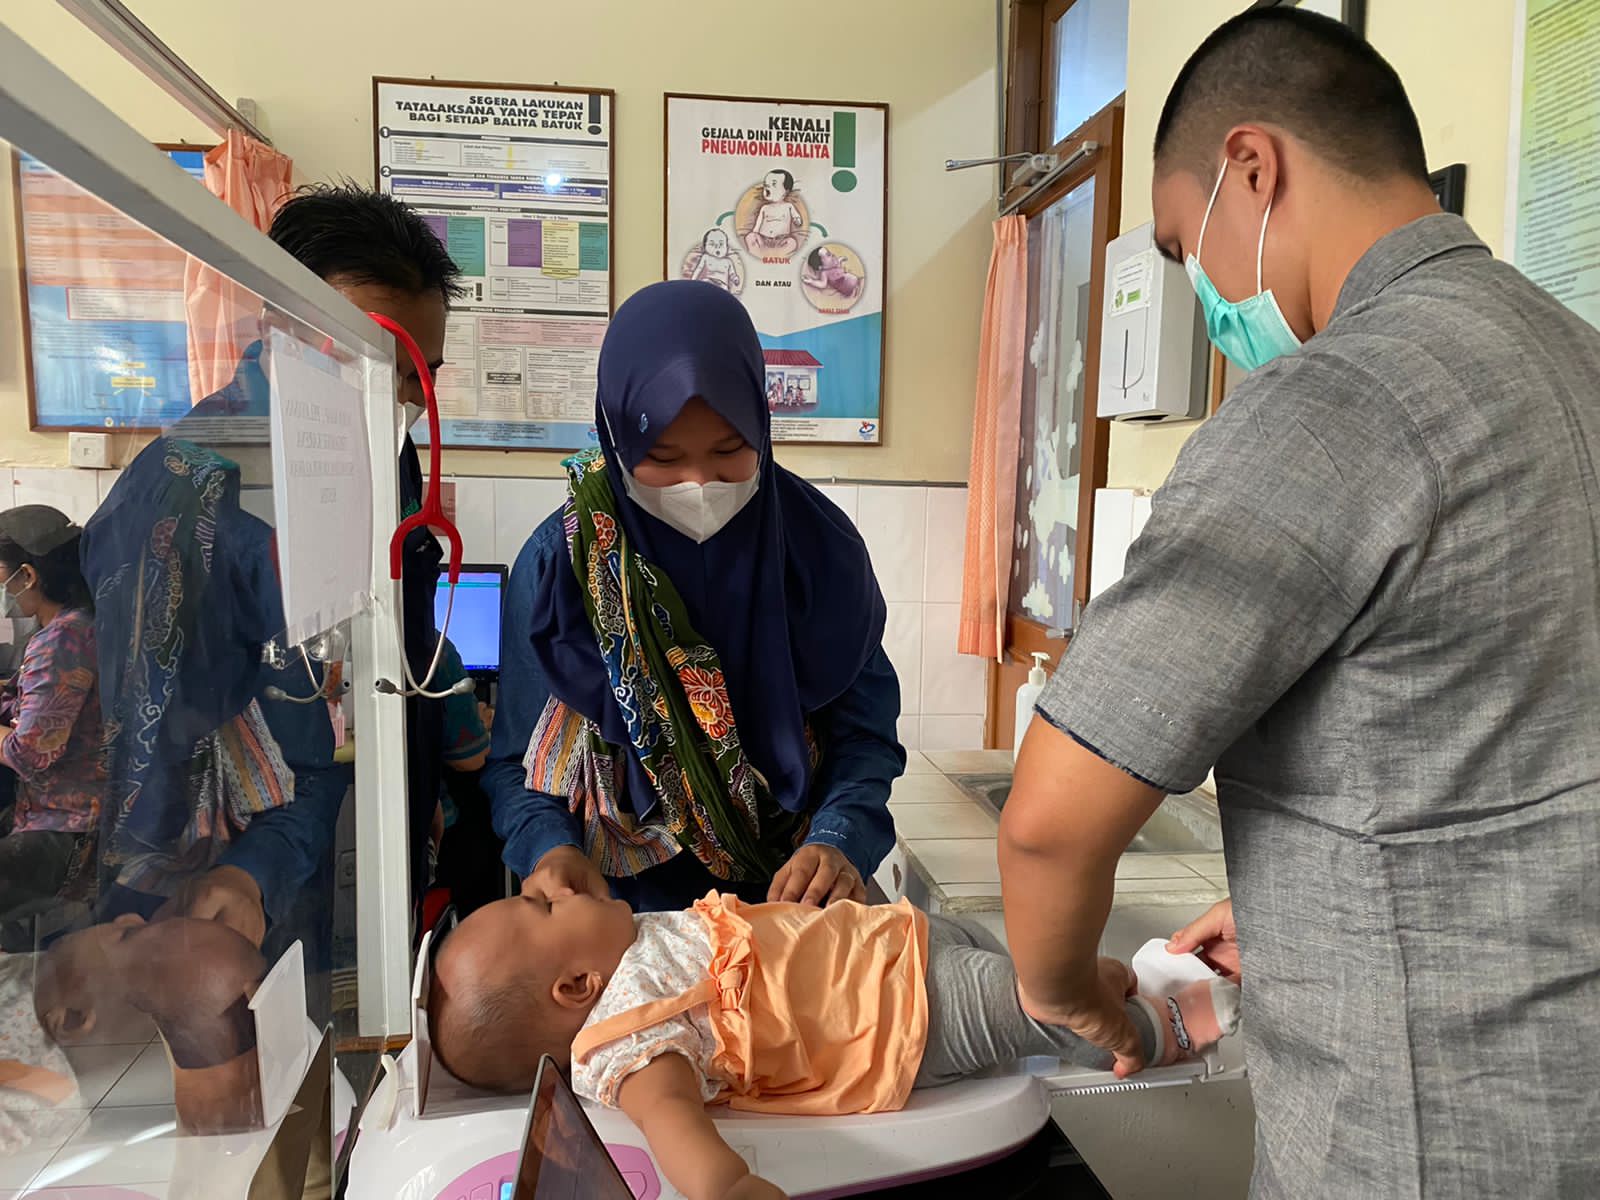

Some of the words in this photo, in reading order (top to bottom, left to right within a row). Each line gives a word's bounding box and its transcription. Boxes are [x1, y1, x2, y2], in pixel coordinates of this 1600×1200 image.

[469, 96, 518, 106] SEGERA
[522, 98, 583, 110] LAKUKAN
[396, 101, 495, 116] TATALAKSANA
[499, 107, 539, 118] YANG
[543, 110, 583, 121] TEPAT
[409, 112, 441, 122] BAGI
[445, 114, 489, 125] SETIAP
[493, 117, 537, 128] BALITA
[541, 120, 583, 130] BATUK
[768, 117, 831, 132] KENALI
[702, 127, 744, 140] GEJALA
[747, 129, 772, 141] DINI
[777, 131, 830, 143] PENYAKIT
[702, 139, 782, 157] PNEUMONIA
[786, 143, 830, 159] BALITA
[762, 257, 791, 265] BATUK
[773, 280, 792, 288] ATAU
